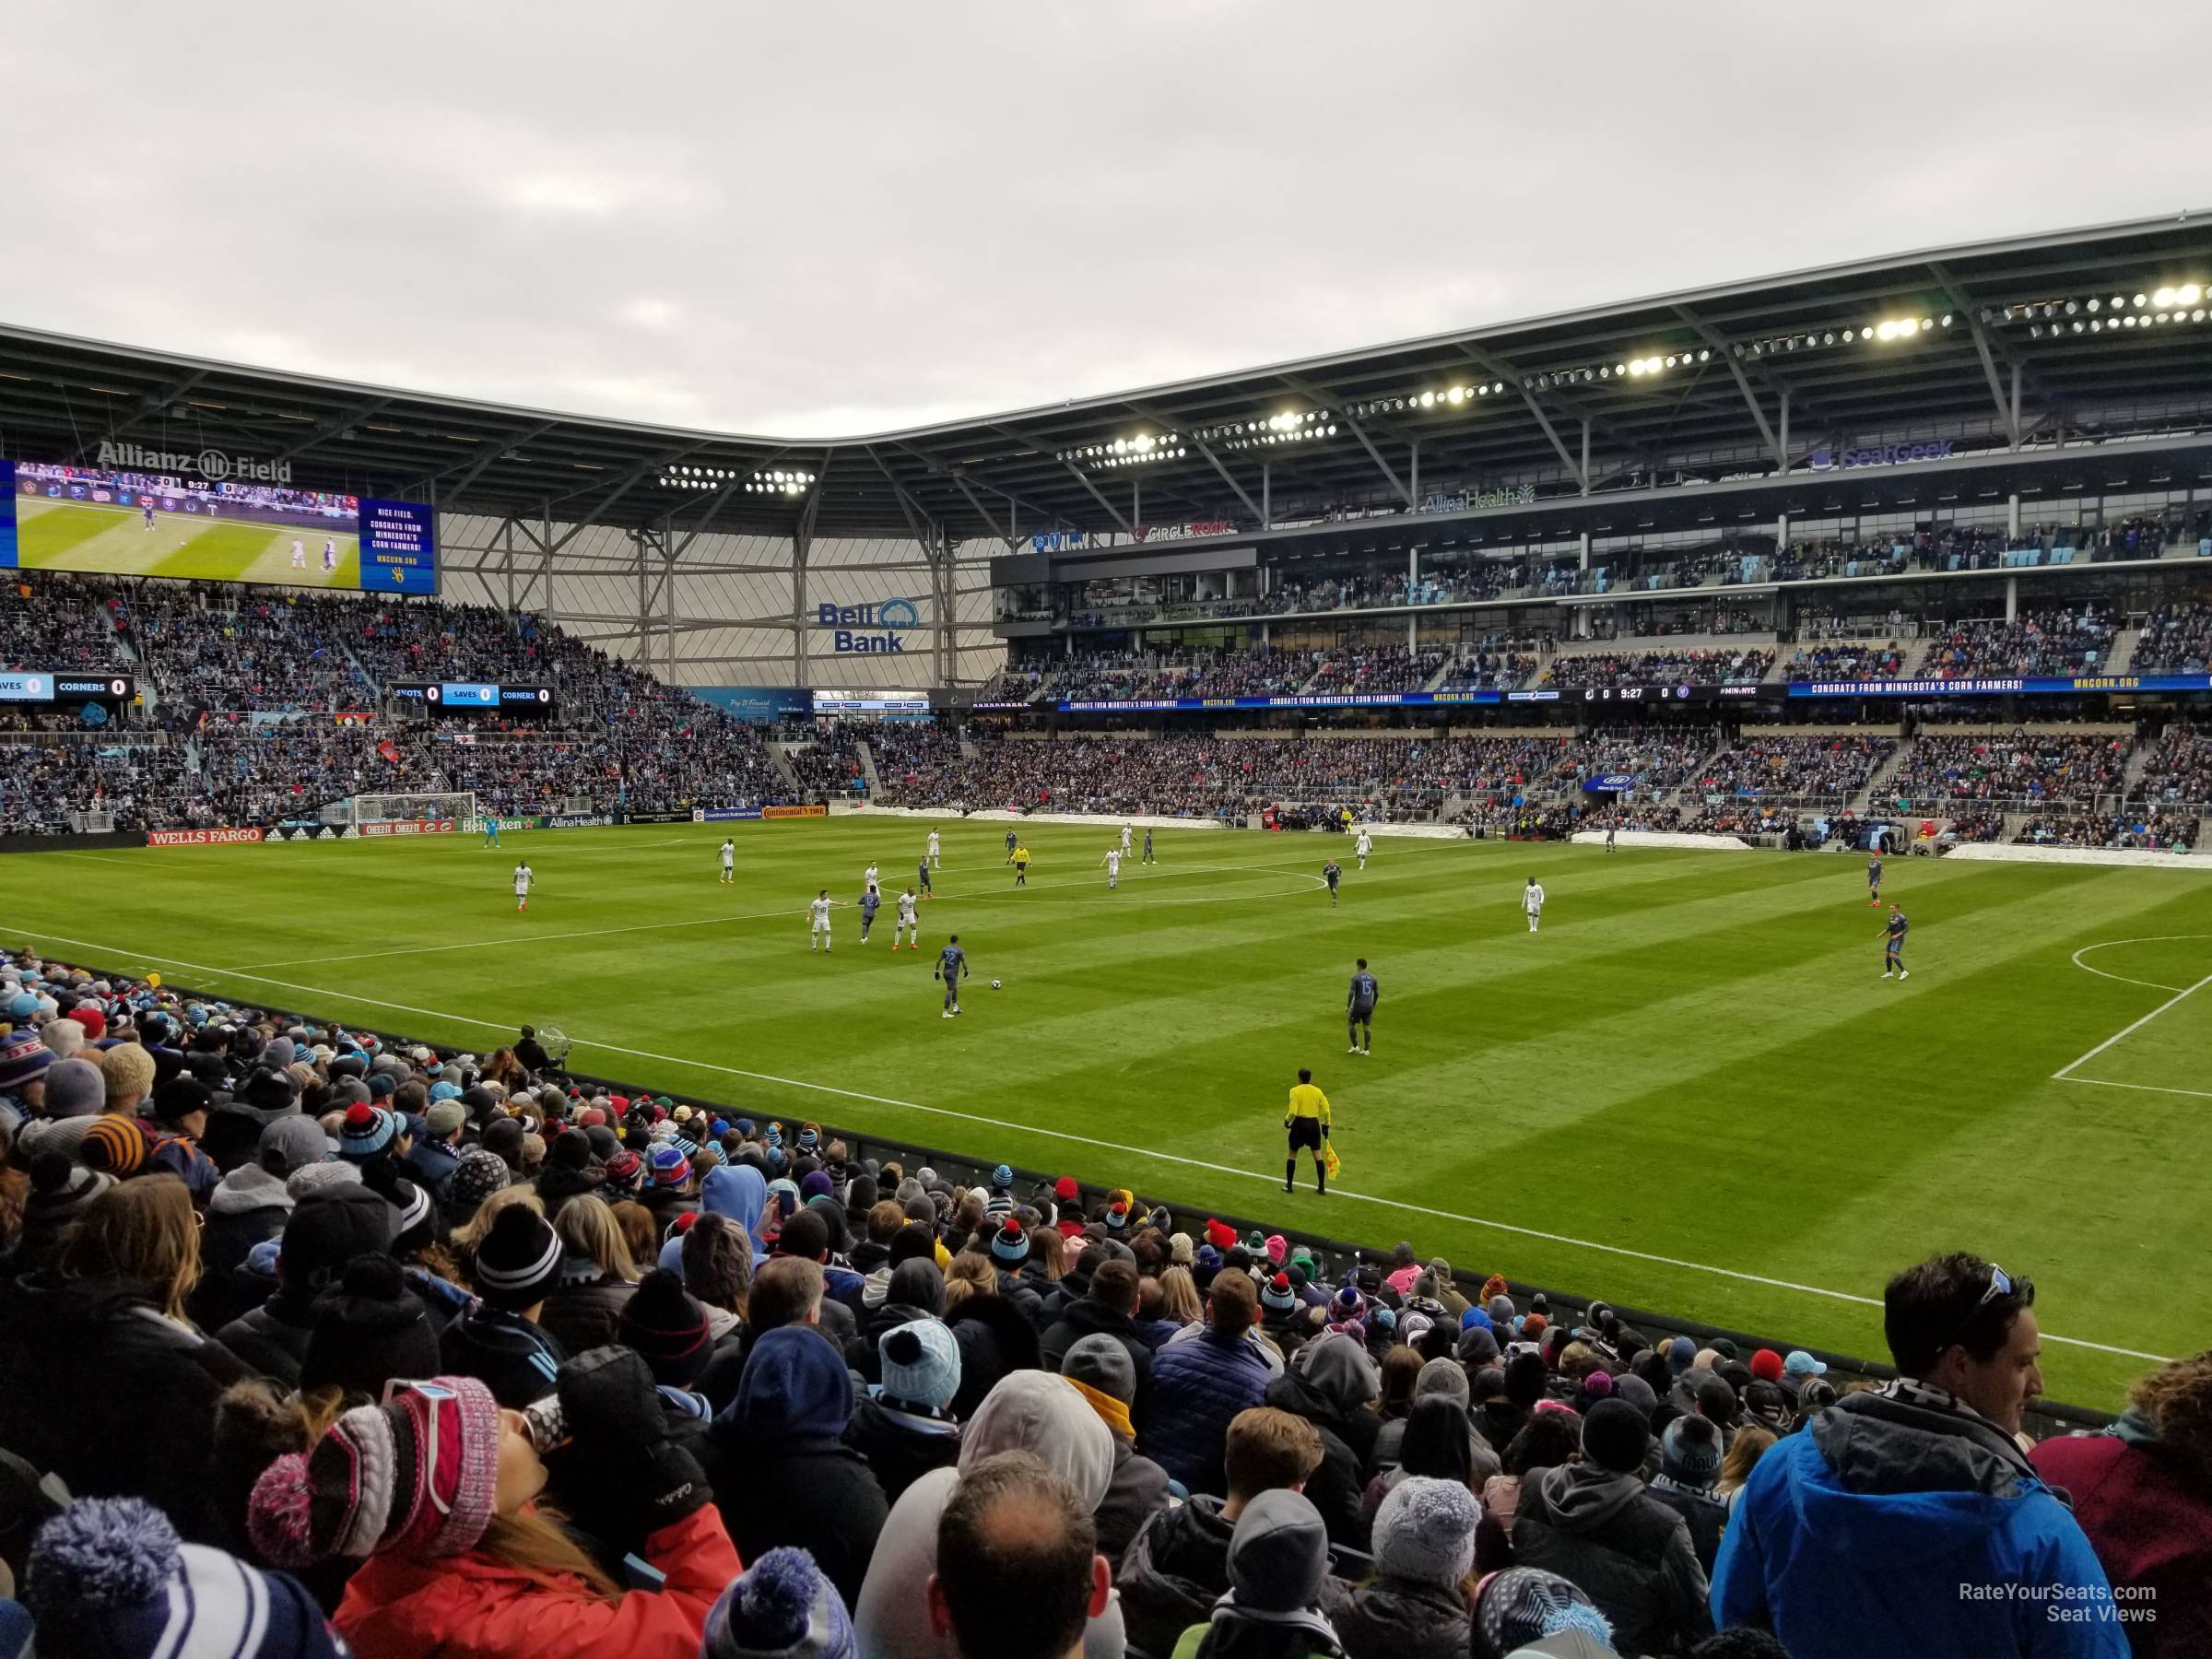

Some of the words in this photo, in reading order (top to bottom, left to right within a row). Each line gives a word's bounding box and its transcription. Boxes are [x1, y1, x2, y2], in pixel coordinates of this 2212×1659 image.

[1843, 440, 1954, 468] SeatGeek
[97, 440, 192, 472] Allianz
[237, 457, 291, 483] Field
[187, 480, 209, 489] 9:27
[1424, 494, 1464, 514] Allina
[1465, 487, 1515, 510] Health
[378, 508, 393, 516] NICE
[370, 520, 403, 531] CONGRATS
[405, 524, 421, 533] FROM
[375, 530, 418, 542] MINNESOTA'S
[371, 540, 389, 548] CORN
[818, 603, 873, 626] Bell
[834, 630, 903, 653] Bank
[59, 683, 106, 691] CORNERS
[112, 679, 126, 695] 0
[1812, 684, 1856, 693] CONGRATS
[1859, 683, 1882, 692] FROM
[1886, 681, 1945, 692] MINNESOTA'S
[1948, 681, 1972, 690] CORN
[1976, 680, 2022, 690] FARMERS!
[2074, 677, 2139, 688] MNCORN.ORG
[427, 687, 439, 700] 0
[480, 688, 490, 701] 0
[502, 691, 535, 700] CORNERS
[539, 688, 549, 702] 0
[1269, 697, 1298, 705] CONGRATS
[1315, 696, 1354, 704] MINNESOTA'S
[1355, 695, 1371, 703] CORN
[1372, 694, 1402, 703] FARMERS!
[1433, 693, 1474, 701] MNCORN.ORG
[1604, 689, 1609, 699] 0
[1620, 688, 1641, 699] 9:27
[1662, 688, 1668, 698] 0
[764, 808, 803, 818] Continental
[463, 819, 523, 832] Heiken
[549, 818, 574, 828] Allina
[575, 815, 602, 827] Health
[152, 831, 206, 845] WELLS
[209, 830, 259, 842] FARGO
[1361, 981, 1371, 994] 15
